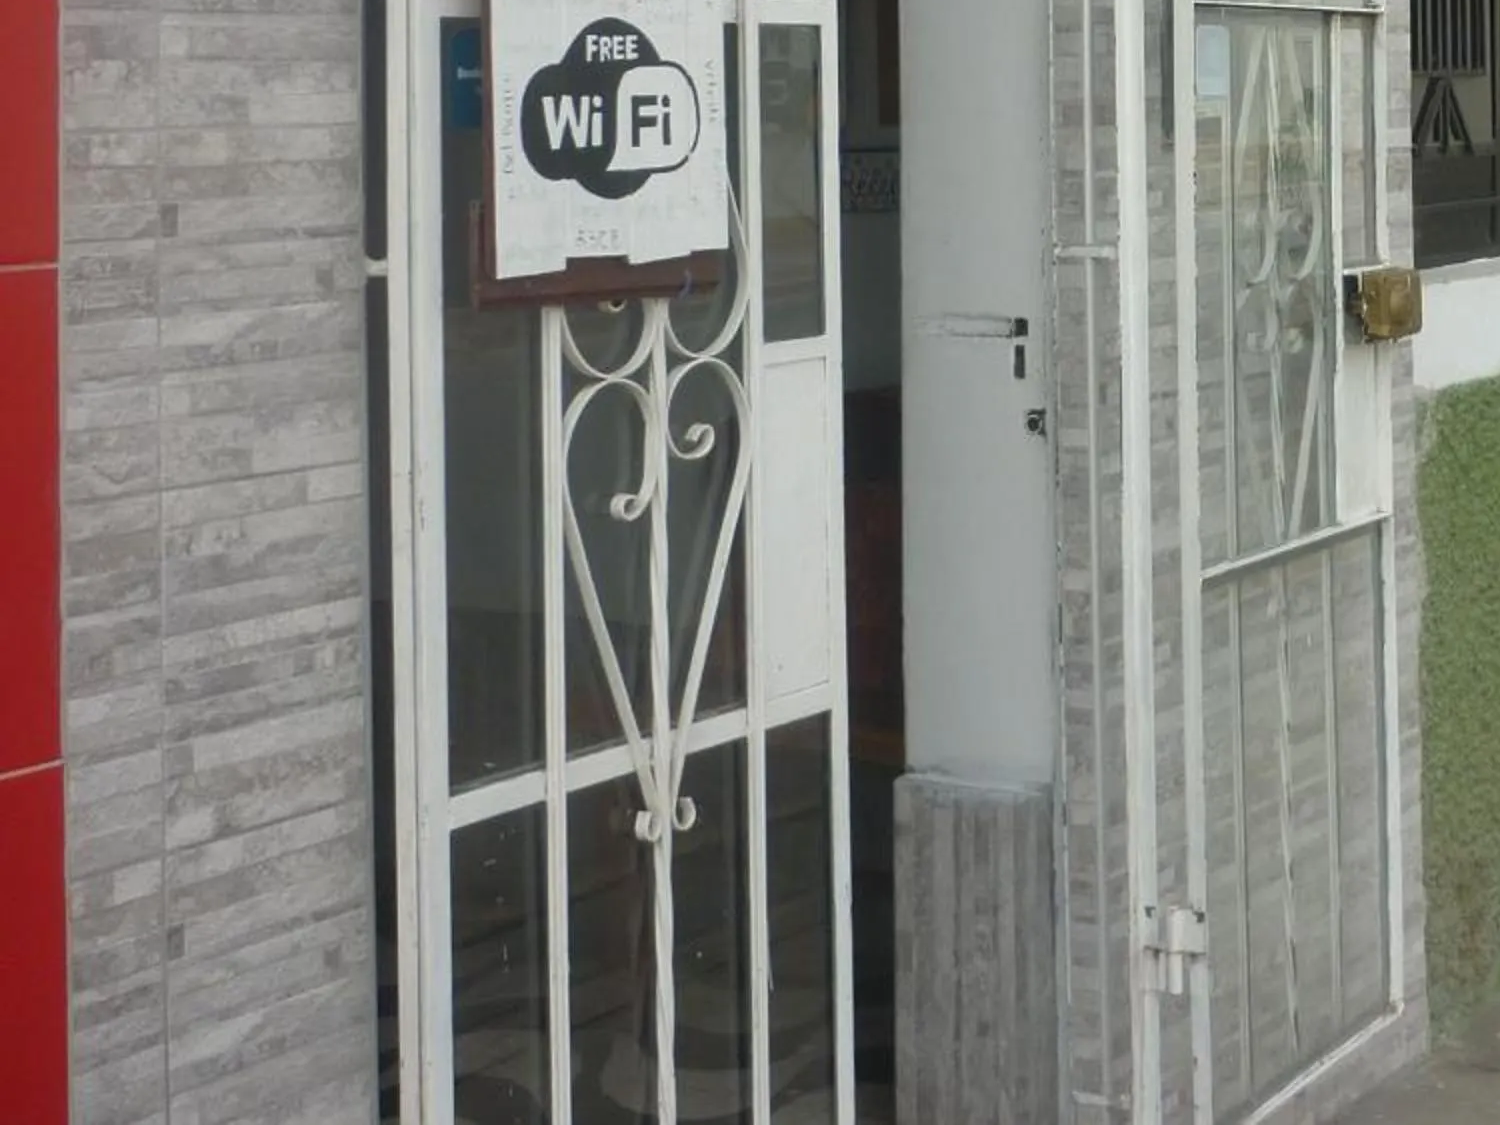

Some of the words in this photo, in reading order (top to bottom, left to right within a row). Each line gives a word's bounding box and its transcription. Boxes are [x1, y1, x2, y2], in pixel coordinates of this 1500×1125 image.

[585, 34, 639, 63] FREE
[541, 94, 603, 151] Wi
[631, 94, 671, 147] Fi
